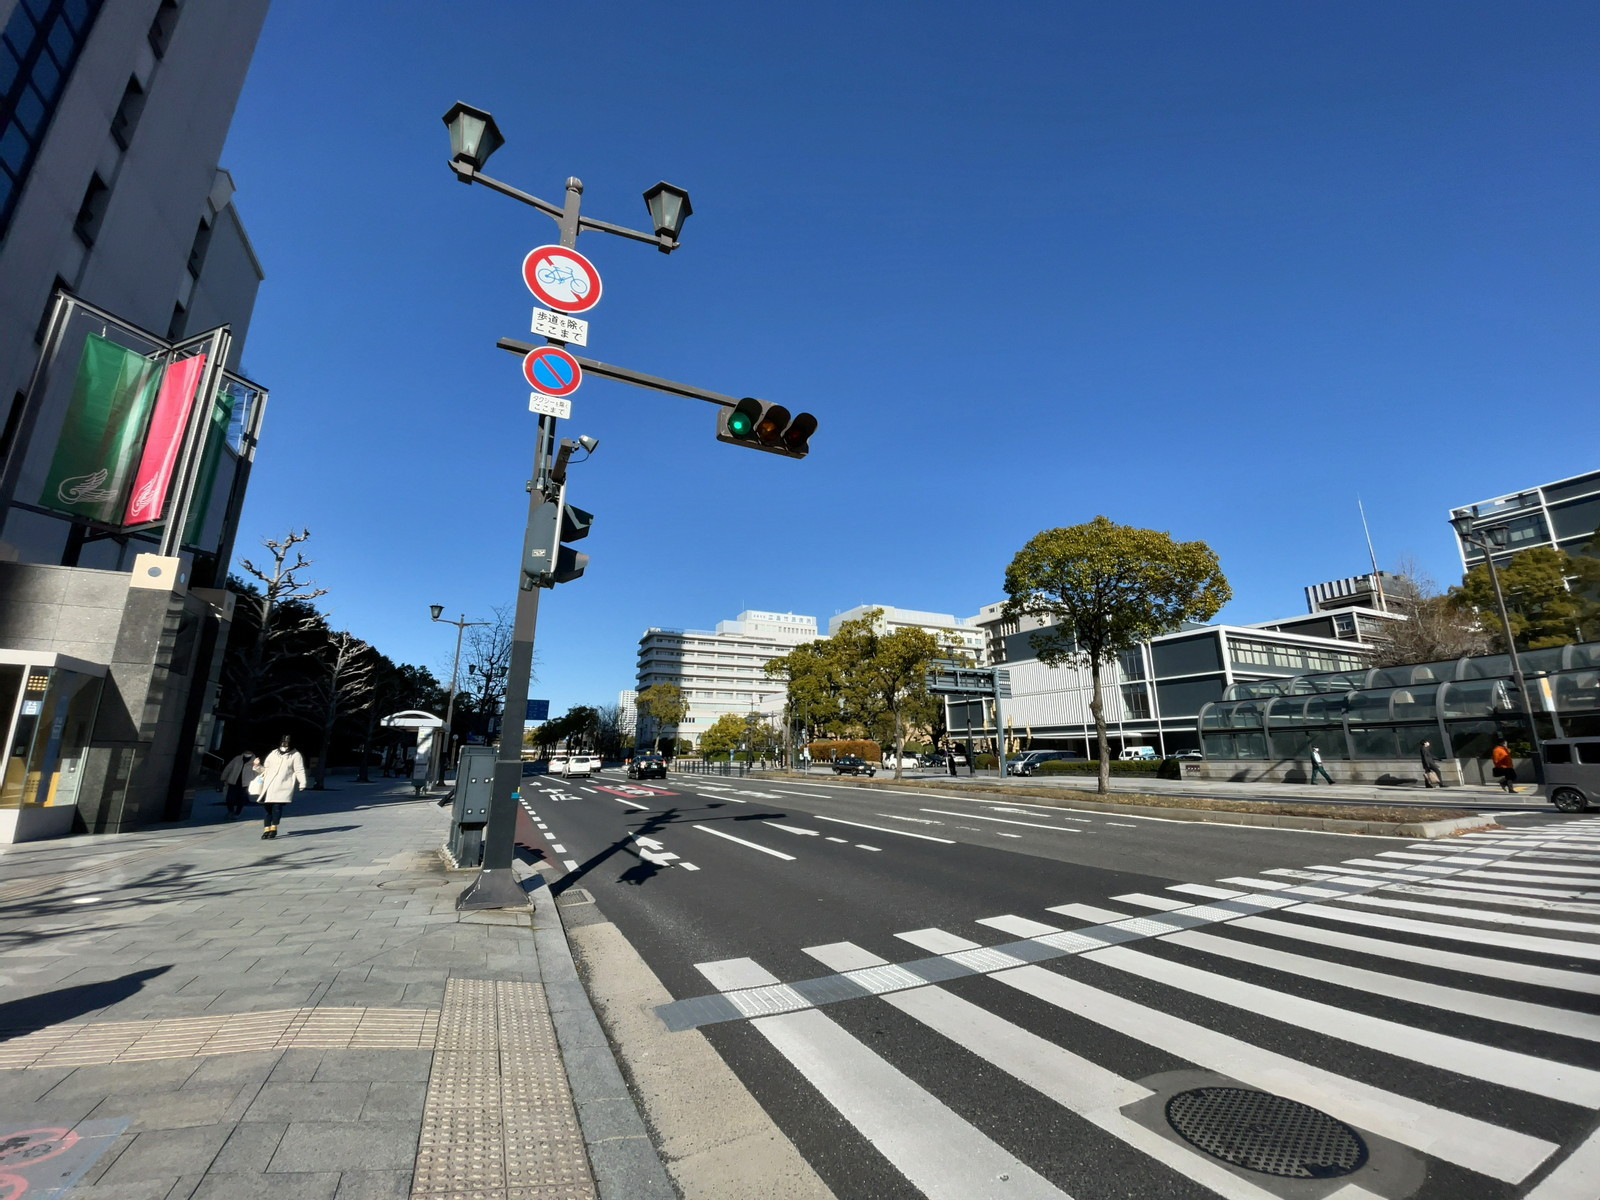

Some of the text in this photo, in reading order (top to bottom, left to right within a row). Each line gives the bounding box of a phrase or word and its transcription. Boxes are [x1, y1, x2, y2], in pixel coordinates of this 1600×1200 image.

[537, 311, 583, 332] 歩道を除く
[536, 322, 583, 341] ここまで
[534, 403, 565, 415] ここまで
